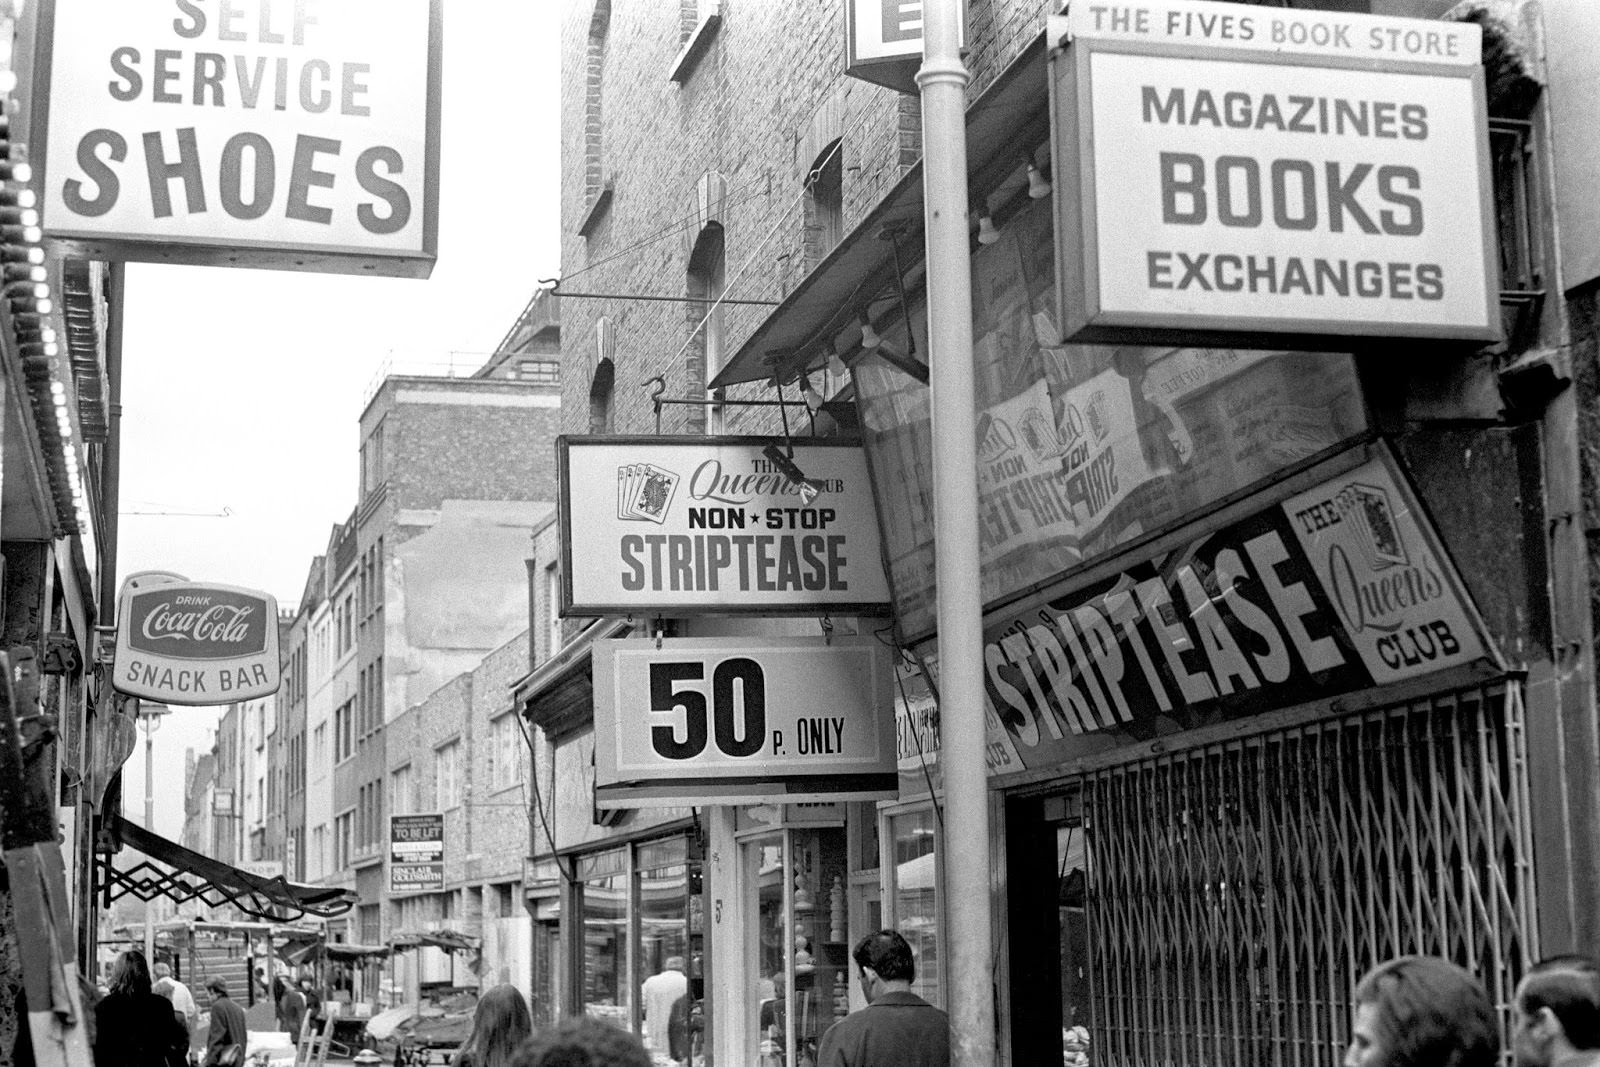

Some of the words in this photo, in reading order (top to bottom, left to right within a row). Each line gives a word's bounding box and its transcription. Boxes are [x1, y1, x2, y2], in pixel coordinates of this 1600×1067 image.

[172, 0, 319, 46] SELF
[1089, 5, 1150, 34] THE
[1166, 11, 1255, 40] FIVES
[1271, 19, 1351, 48] BOOK
[1369, 27, 1459, 57] STORE
[108, 46, 371, 117] SERVICE
[1141, 85, 1429, 140] MAGAZINES
[62, 126, 412, 235] SHOES
[1159, 151, 1425, 236] BOOKS
[1146, 250, 1444, 301] EXCHANGES
[688, 507, 745, 529] NON
[766, 508, 836, 529] STOP
[1295, 499, 1342, 535] THE
[620, 534, 848, 591] STRIPTEASE
[1329, 543, 1443, 633] Queens
[175, 595, 212, 606] DRINK
[984, 529, 1347, 748] STRIPTEASE
[1377, 619, 1460, 670] CLUB
[127, 660, 206, 693] SNACK
[219, 663, 268, 692] BAR
[649, 657, 766, 760] 50
[797, 717, 845, 755] ONLY
